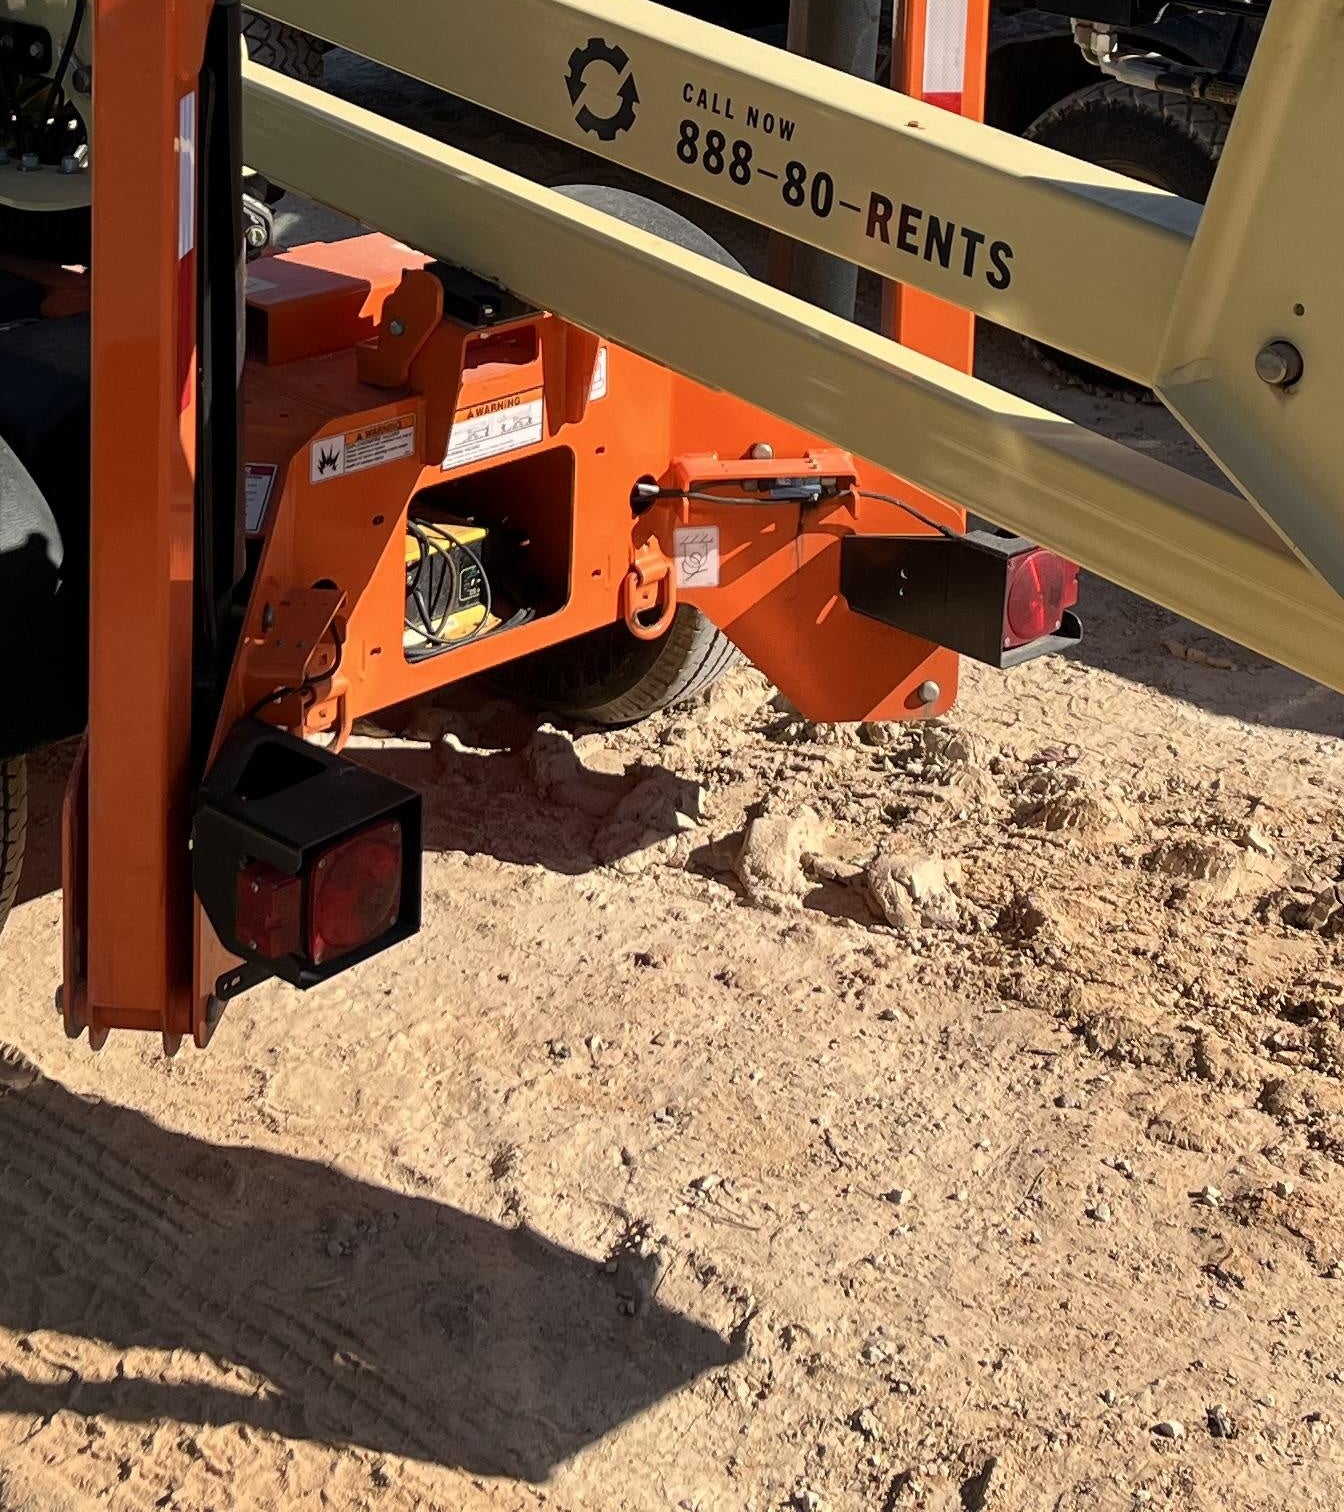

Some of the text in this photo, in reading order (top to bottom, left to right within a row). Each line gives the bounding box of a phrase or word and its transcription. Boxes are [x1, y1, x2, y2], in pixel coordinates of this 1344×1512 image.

[683, 82, 796, 142] CALL NOW
[676, 119, 1015, 291] 888-80-RENTS
[476, 396, 521, 417] WARNING
